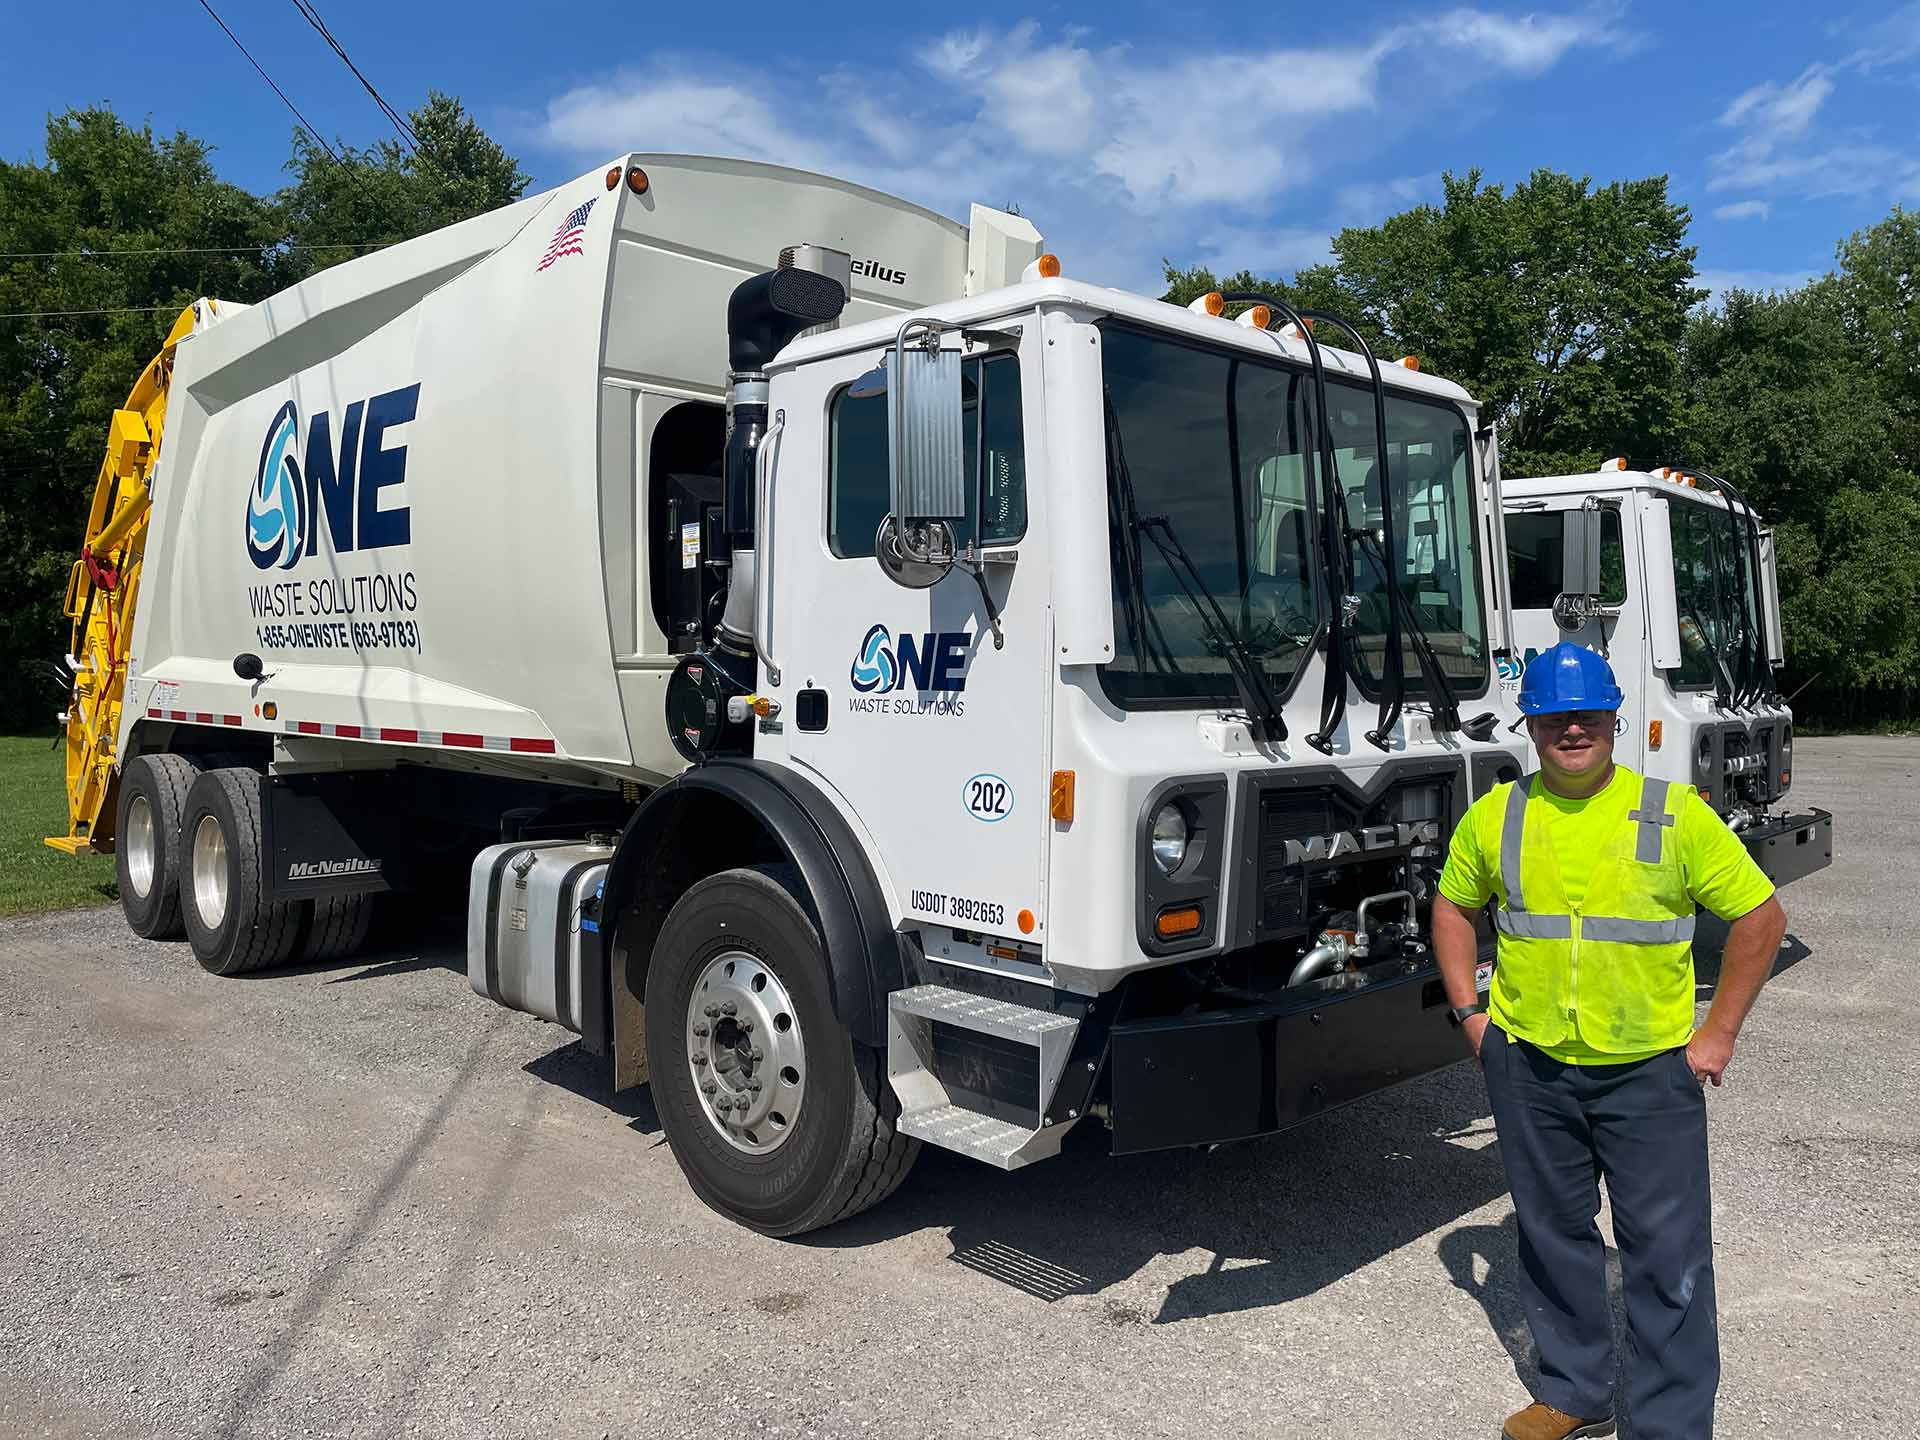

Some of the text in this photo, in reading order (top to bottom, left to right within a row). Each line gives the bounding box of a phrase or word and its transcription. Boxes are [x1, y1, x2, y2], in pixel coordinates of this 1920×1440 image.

[850, 260, 907, 285] eilus
[245, 381, 422, 570] ONE
[248, 571, 418, 618] WASTE SOLUTIONS
[256, 619, 422, 654] 1-855-ONEWSTE (663-9783)
[850, 623, 972, 694] ONE
[1499, 682, 1518, 691] STE
[849, 698, 965, 717] WASTE SOLUTIONS
[971, 780, 1006, 814] 202
[1283, 820, 1439, 864] MACK
[288, 857, 382, 877] McNeilus
[911, 889, 1004, 925] USDOT 3892653
